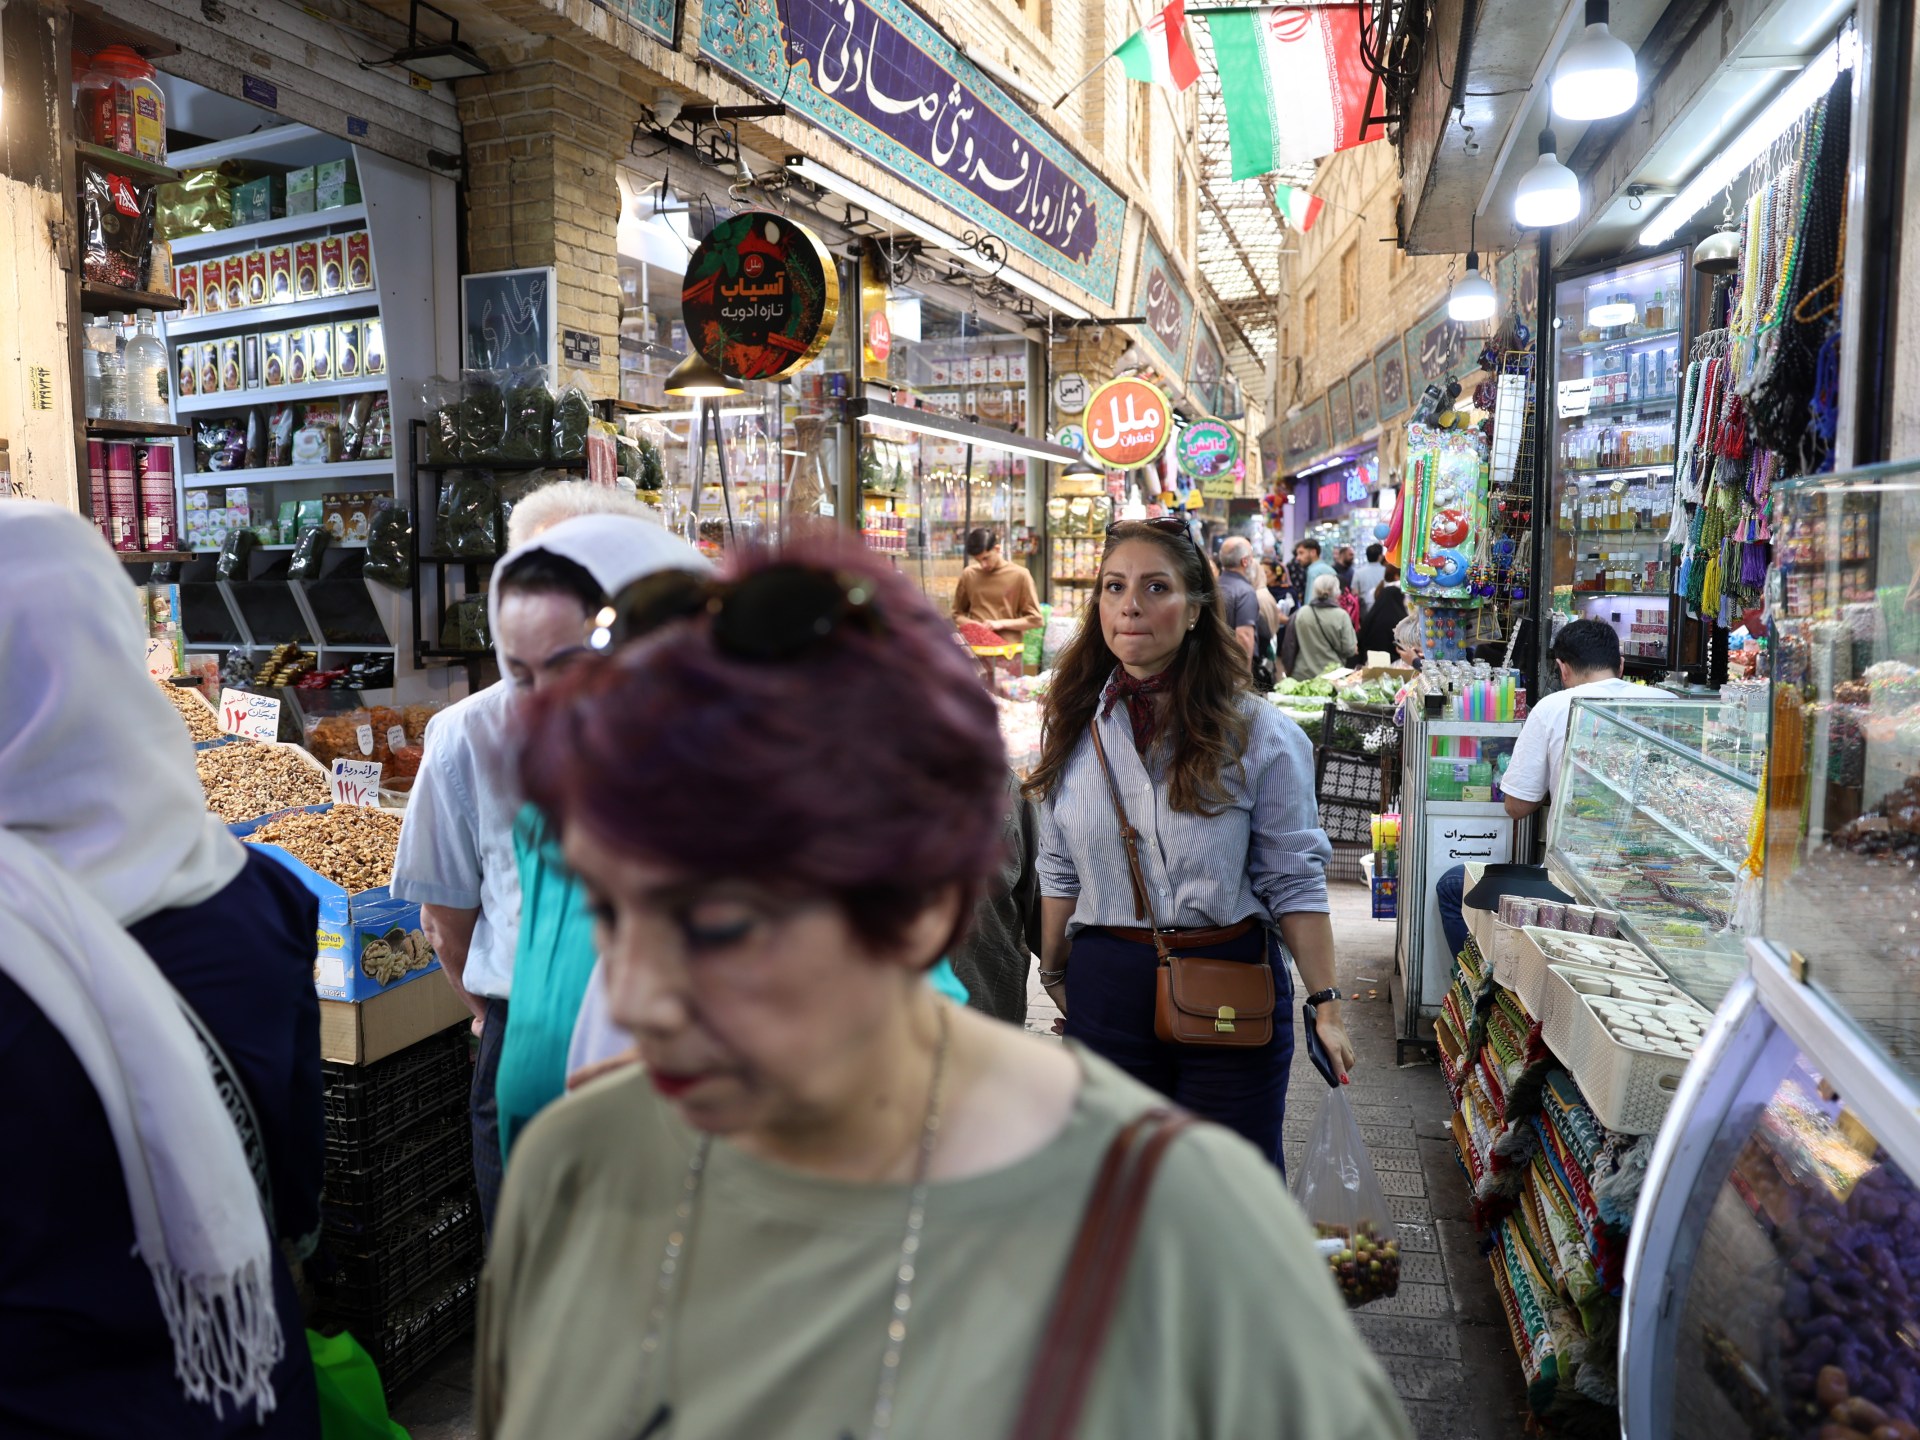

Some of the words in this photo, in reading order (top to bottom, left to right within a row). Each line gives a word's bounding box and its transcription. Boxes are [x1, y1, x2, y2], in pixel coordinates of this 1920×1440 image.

[746, 259, 762, 272] ملل
[720, 272, 785, 303] آسیاب
[721, 303, 757, 322] ادویه
[760, 303, 784, 321] تازه
[870, 320, 889, 344] ملل
[1092, 393, 1160, 449] ملل
[1119, 431, 1155, 447] زعفران
[1187, 437, 1228, 456] دانش
[1444, 829, 1498, 841] تعمیرات
[1449, 847, 1491, 859] تسبیح
